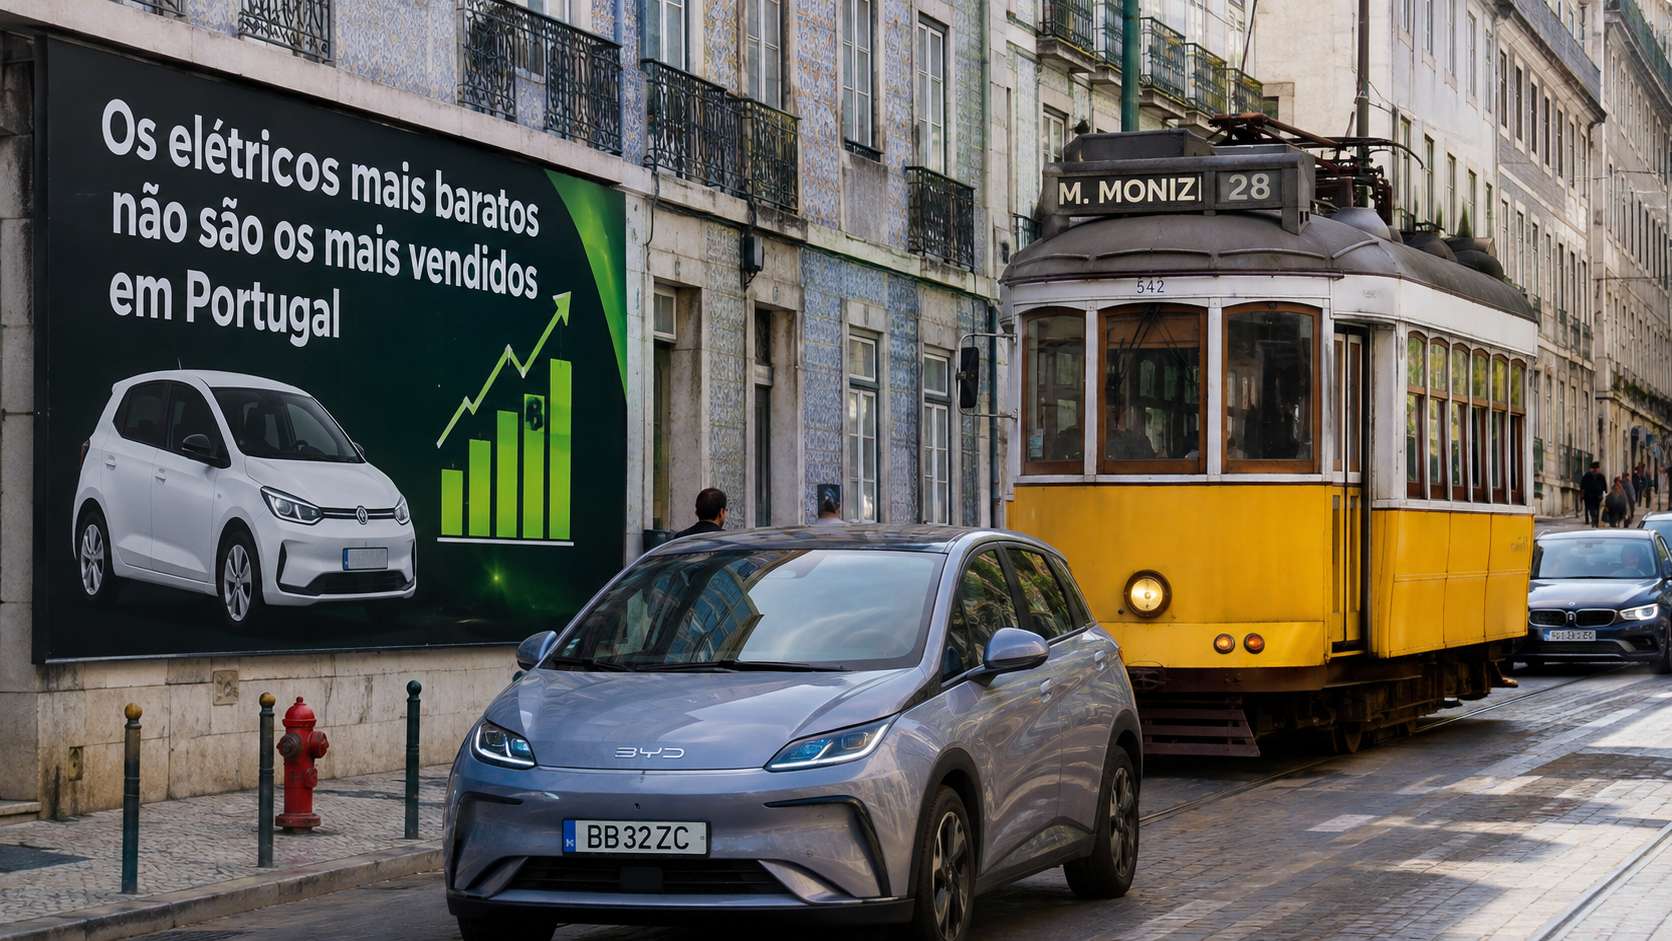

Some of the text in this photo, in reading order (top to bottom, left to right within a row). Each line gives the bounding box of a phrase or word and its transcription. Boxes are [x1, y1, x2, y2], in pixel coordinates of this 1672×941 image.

[101, 98, 540, 238] Os elétricos mais baratos
[1058, 177, 1196, 205] M. MONIZ
[1227, 173, 1272, 200] 28
[112, 181, 538, 300] não são os mais vendidos
[1136, 280, 1165, 293] 542
[109, 269, 340, 348] em Portugal
[614, 746, 685, 759] BYD
[587, 824, 690, 850] BB32ZC
